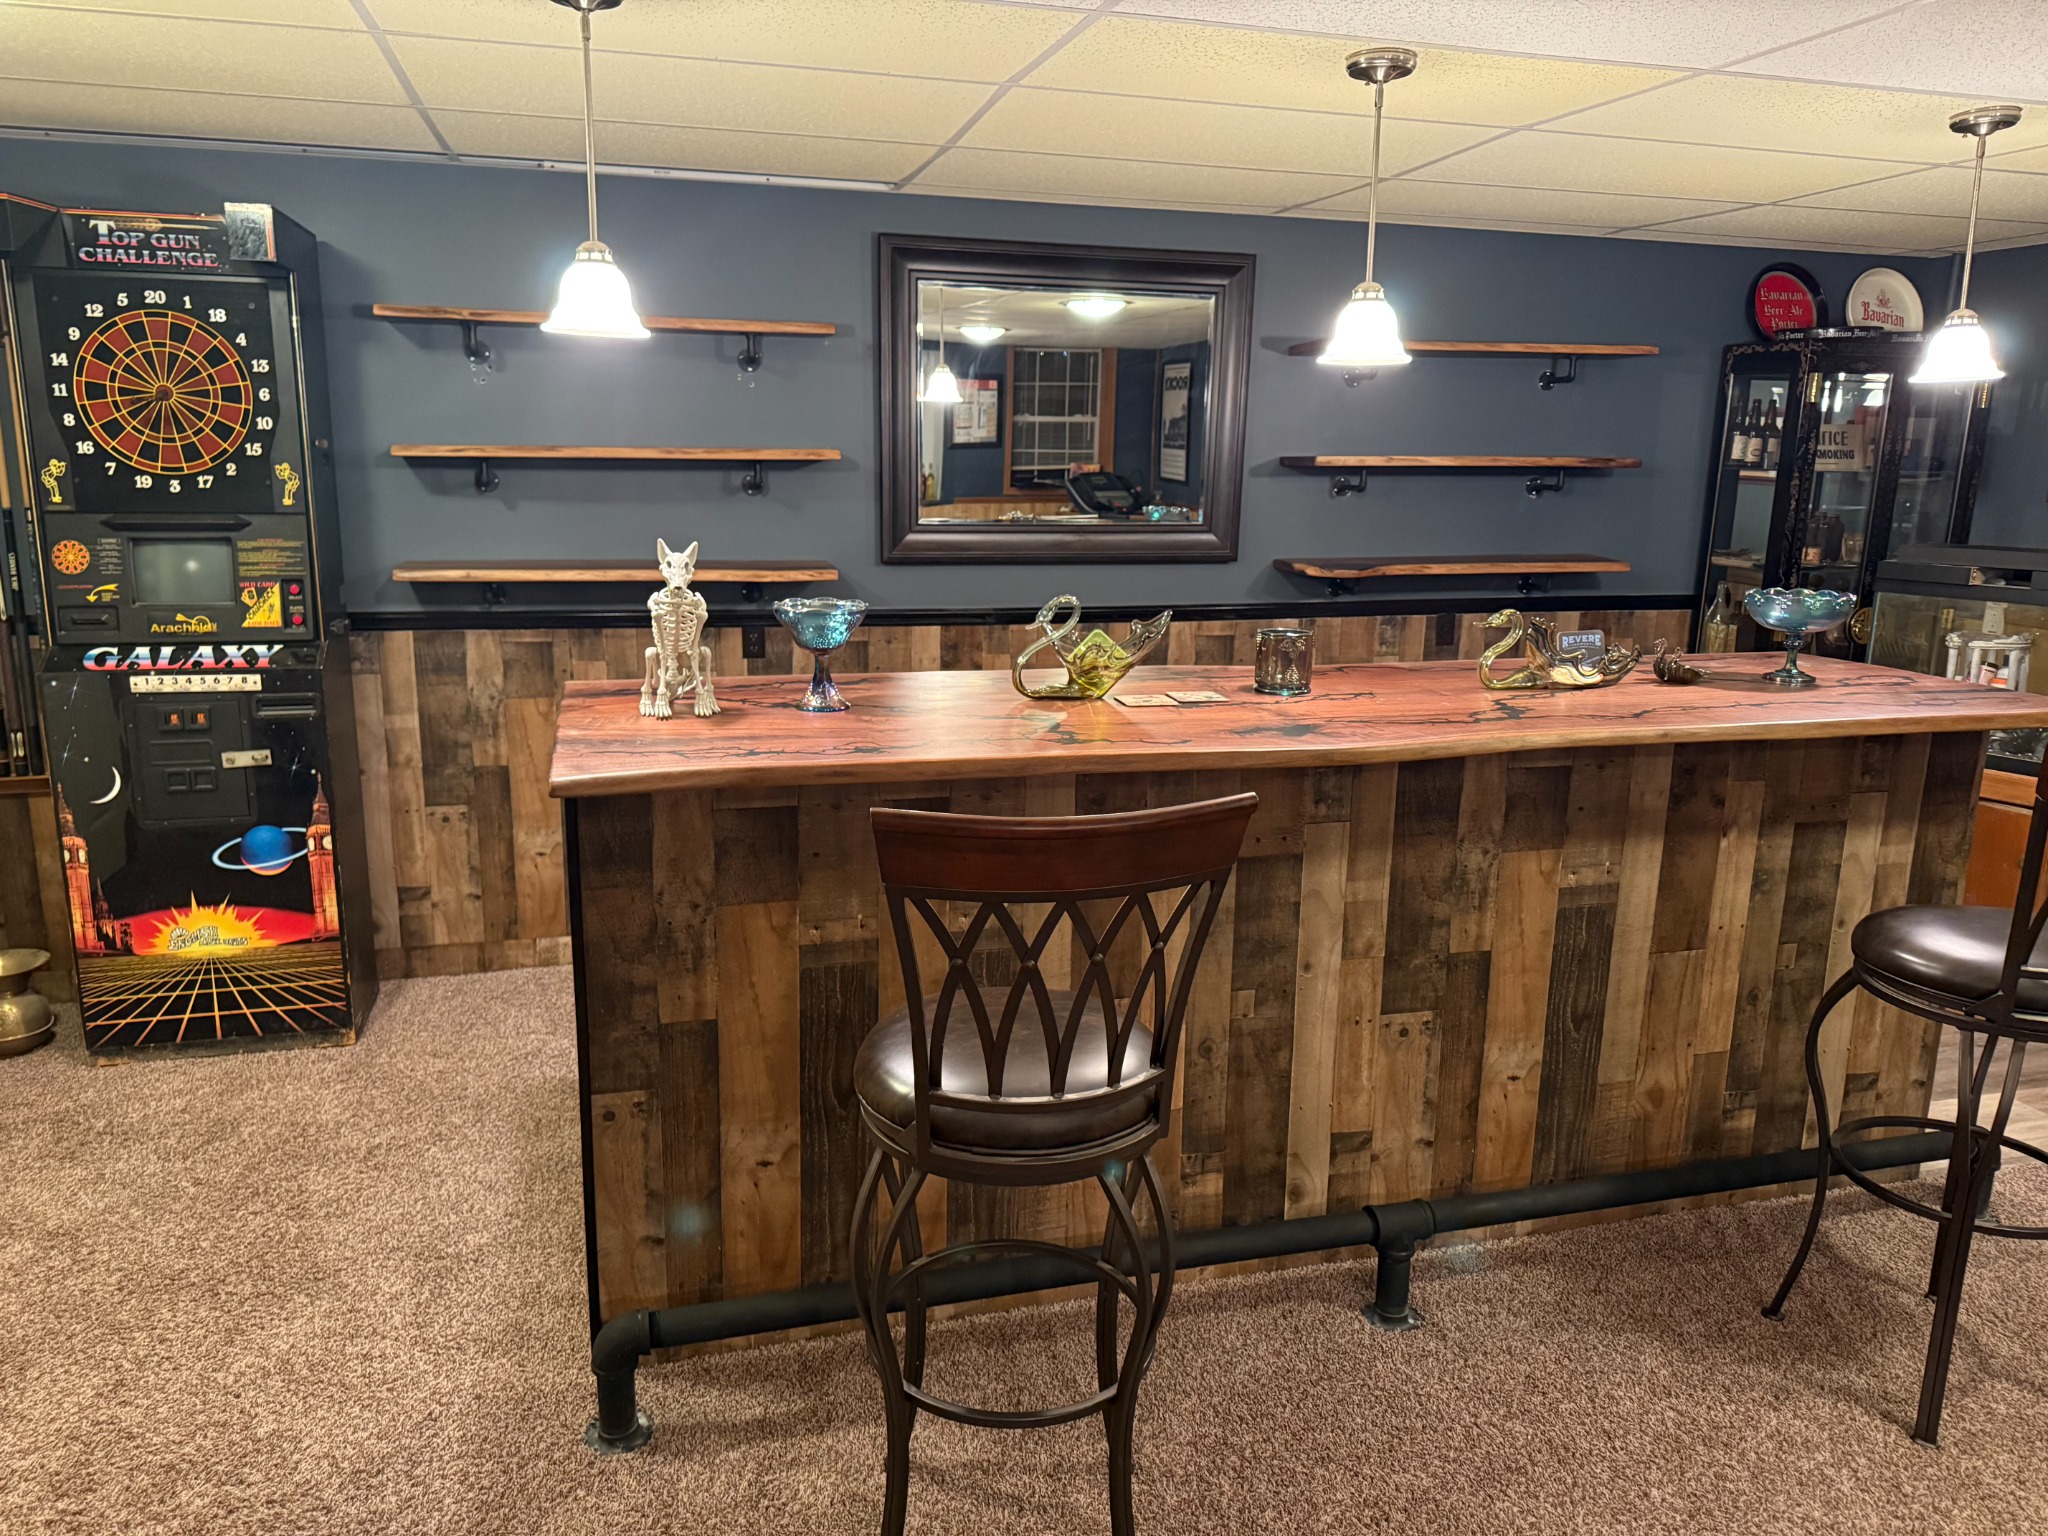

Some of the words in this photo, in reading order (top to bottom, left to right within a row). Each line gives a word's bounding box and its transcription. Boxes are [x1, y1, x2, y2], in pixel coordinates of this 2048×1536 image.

[88, 219, 145, 246] TOP
[150, 233, 200, 249] GUN
[78, 247, 219, 267] CHALLENGE
[116, 293, 128, 306] 5
[144, 290, 166, 304] 20
[183, 295, 192, 309] 1
[84, 304, 103, 317] 12
[208, 309, 226, 322] 18
[1861, 300, 1904, 328] Bavarian
[68, 327, 80, 340] 9
[235, 333, 247, 346] 4
[50, 353, 68, 366] 14
[251, 359, 270, 372] 13
[52, 383, 69, 396] 11
[259, 388, 270, 401] 6
[63, 413, 75, 426] 8
[256, 417, 273, 430] 10
[1821, 430, 1849, 446] TICE
[76, 440, 95, 454] 16
[245, 443, 262, 456] 15
[105, 462, 117, 475] 7
[226, 463, 237, 476] 2
[135, 475, 153, 489] 19
[169, 480, 181, 493] 3
[197, 475, 214, 489] 17
[1561, 634, 1602, 648] REVERE
[82, 644, 285, 671] GALAXY
[157, 677, 164, 685] 2
[171, 677, 178, 685] 3
[241, 676, 248, 684] 8
